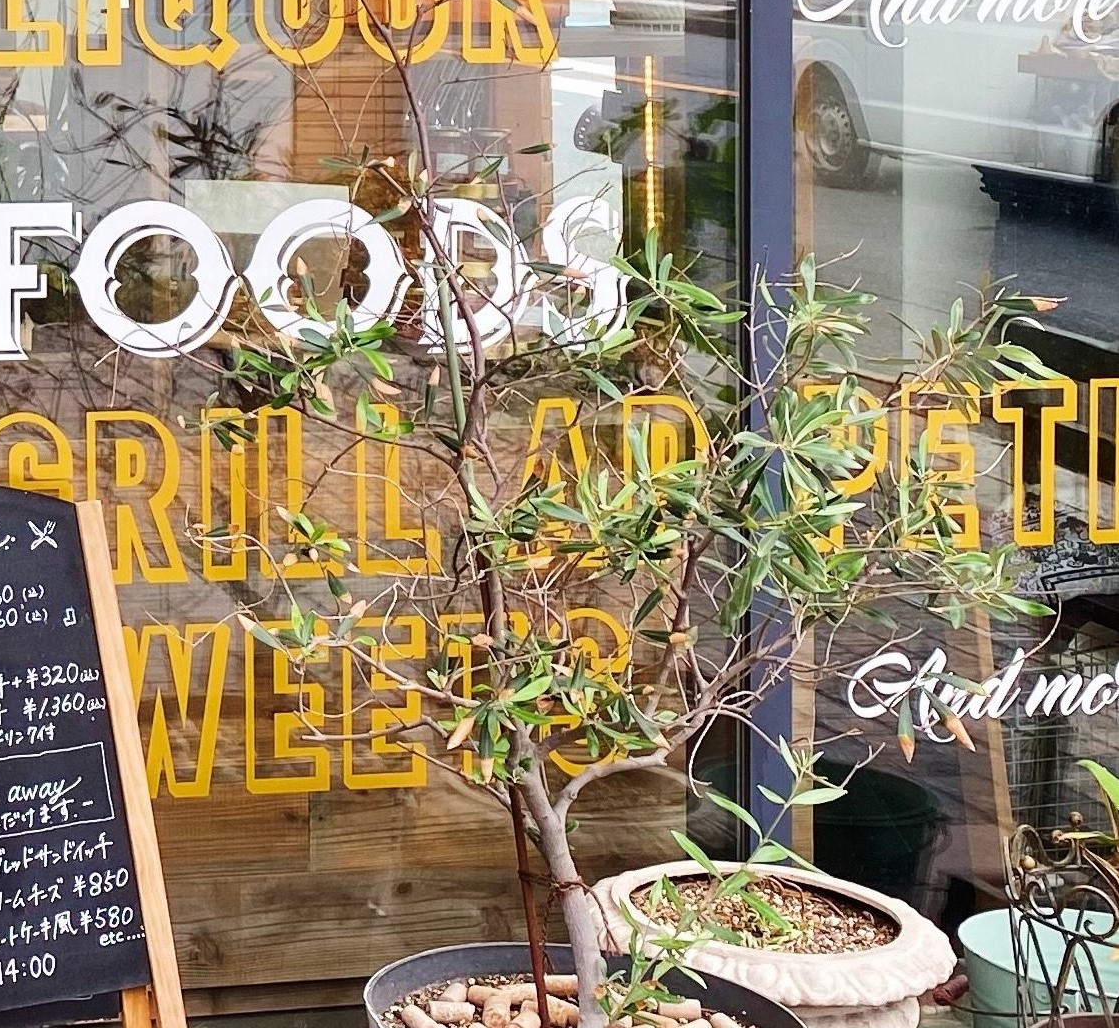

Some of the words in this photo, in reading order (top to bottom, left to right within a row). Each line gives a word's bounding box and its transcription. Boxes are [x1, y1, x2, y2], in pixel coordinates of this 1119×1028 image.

[1024, 660, 1119, 718] mo
[7, 775, 84, 806] away
[72, 866, 130, 898] ¥850
[79, 904, 134, 935] ¥580
